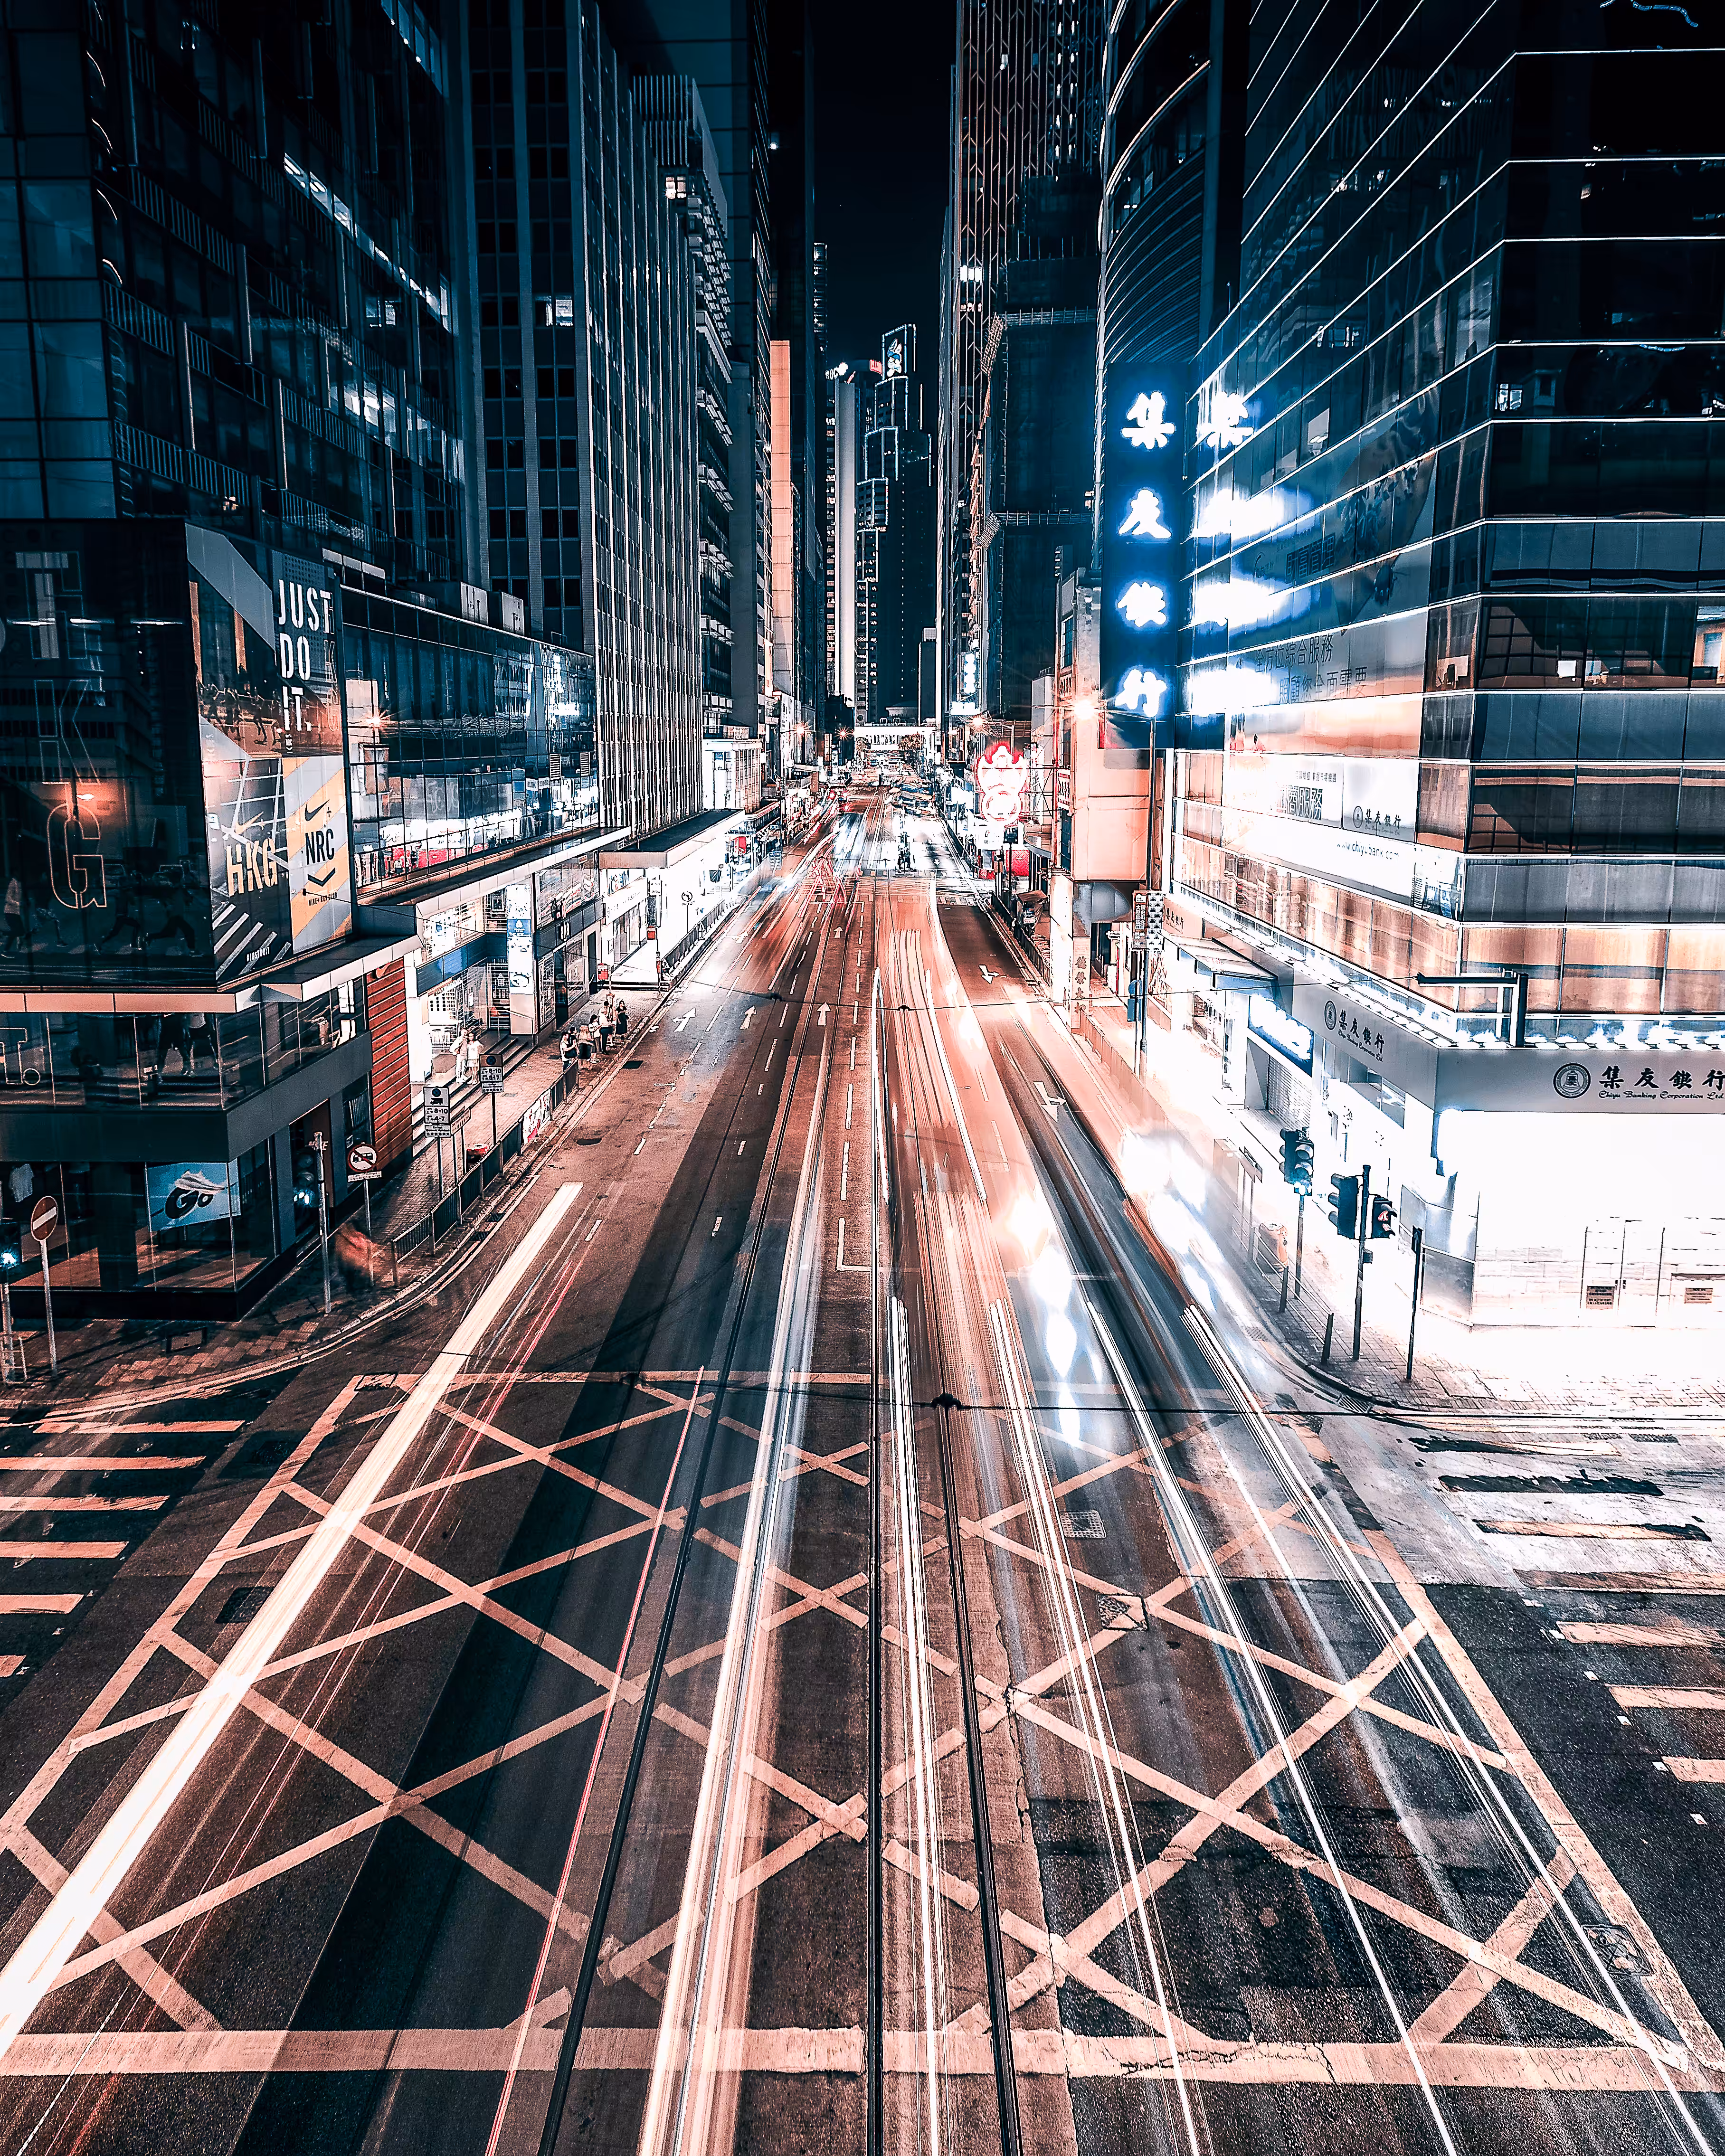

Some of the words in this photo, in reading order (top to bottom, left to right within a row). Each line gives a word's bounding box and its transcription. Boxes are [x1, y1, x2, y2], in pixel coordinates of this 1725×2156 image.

[279, 579, 331, 633] JUST
[280, 633, 311, 680] DO
[1254, 634, 1333, 672] 全方位綜合服務
[283, 686, 313, 732] IT.
[1365, 809, 1401, 829] 集友銀行
[226, 838, 278, 897] HKG
[305, 829, 335, 865] NRC
[1339, 1009, 1384, 1054] 集友銀行
[1599, 1065, 1725, 1092] 集友銀行
[1599, 1090, 1621, 1099] Chiyu
[1623, 1090, 1657, 1100] Banking
[1659, 1091, 1704, 1100] Corporation
